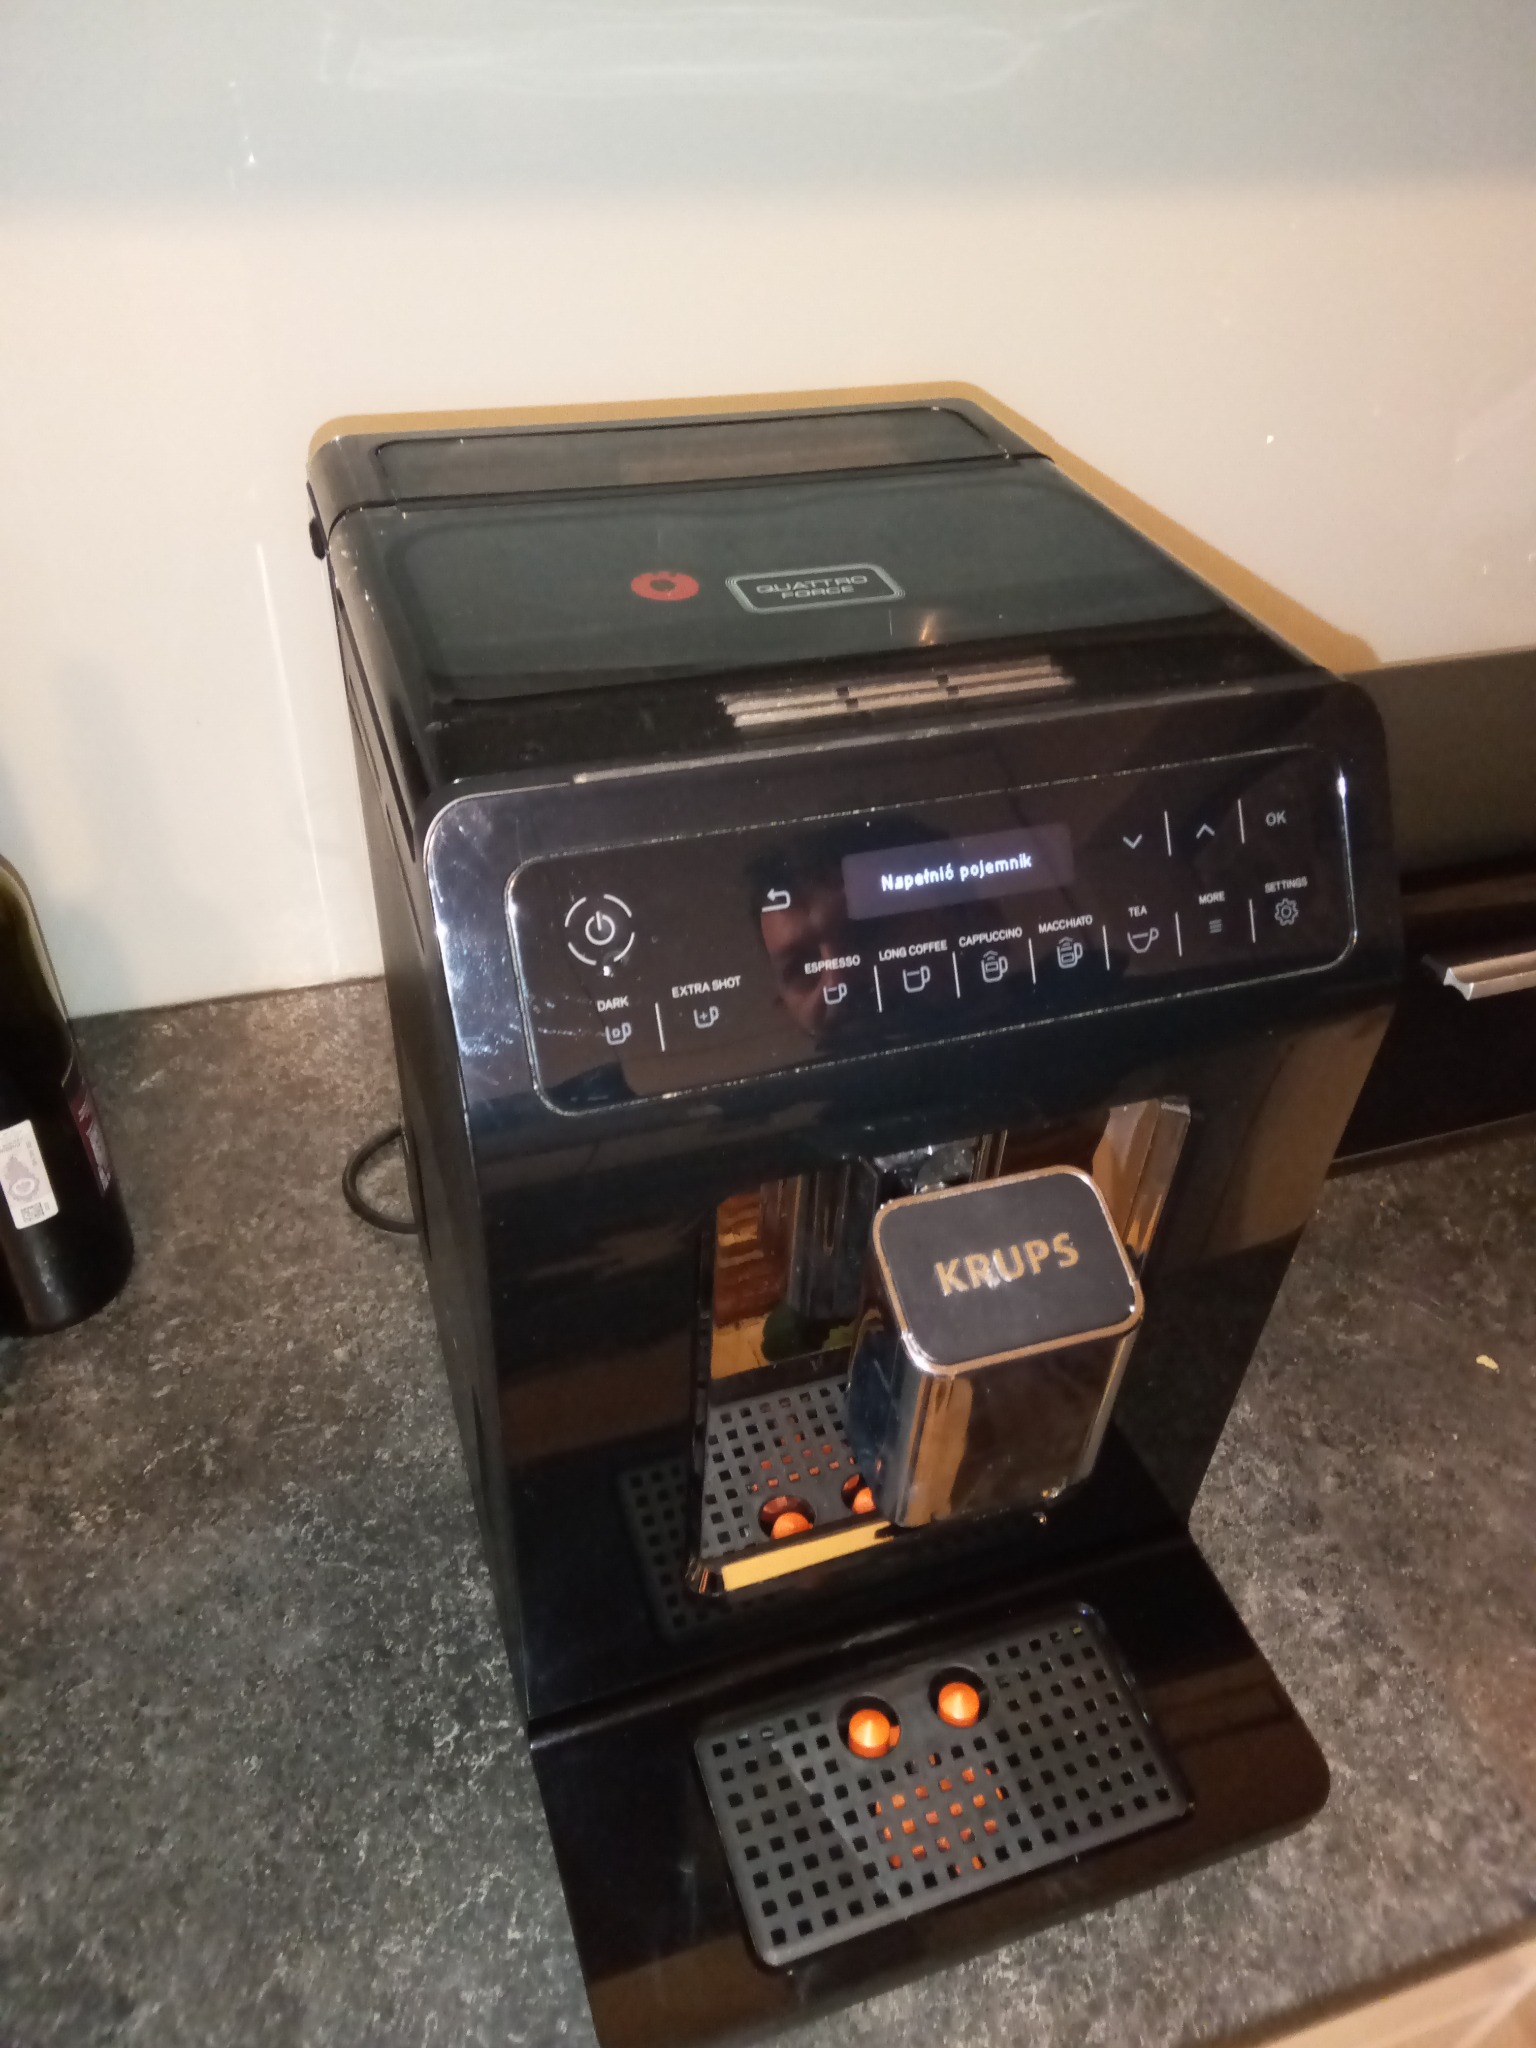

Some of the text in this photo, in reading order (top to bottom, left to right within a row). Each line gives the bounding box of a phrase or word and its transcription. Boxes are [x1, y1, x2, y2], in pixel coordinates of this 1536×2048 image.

[756, 575, 867, 594] QUATTRO
[781, 585, 854, 599] FORCE
[1265, 811, 1287, 827] OK
[959, 852, 1032, 882] pojemnik
[1264, 876, 1308, 894] SETTINGS
[1198, 890, 1225, 905] MORE
[1128, 905, 1148, 917] TEA
[1038, 914, 1093, 934] MACCHIATO
[958, 926, 1023, 948] CAPPUCCINO
[878, 939, 947, 962] LONG COFFEE
[804, 954, 861, 974] ESPRESSO
[671, 975, 741, 999] EXTRA SHOT
[596, 995, 630, 1012] DARK
[933, 1231, 1080, 1298] KRUPS
